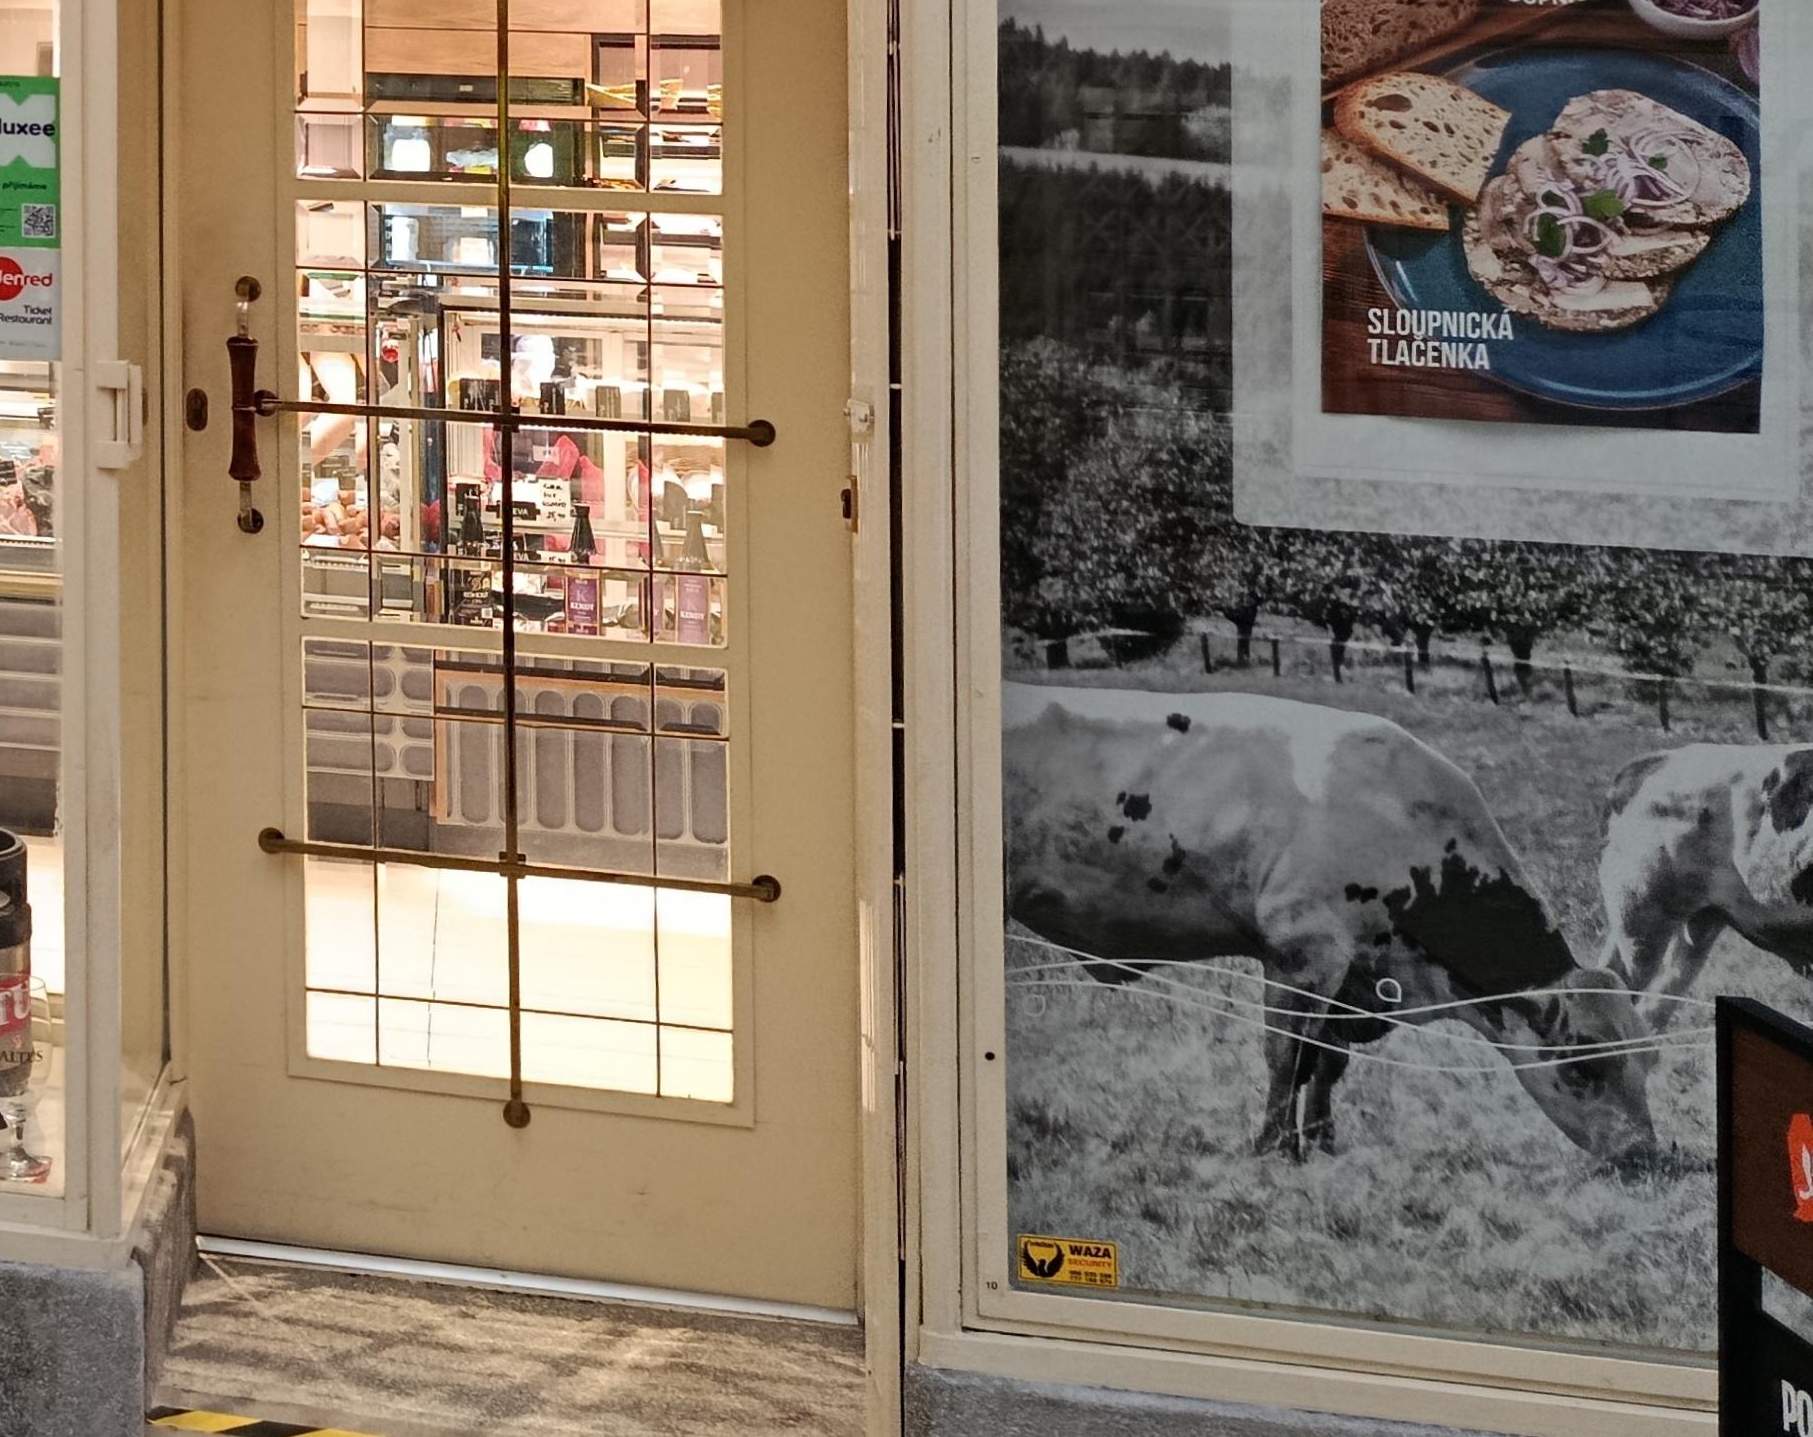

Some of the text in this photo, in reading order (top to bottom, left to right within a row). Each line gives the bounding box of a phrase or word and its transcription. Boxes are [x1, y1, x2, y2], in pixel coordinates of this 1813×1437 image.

[24, 305, 53, 316] Ticket
[1367, 307, 1515, 341] SLOUPNICKÁ
[1367, 334, 1491, 370] TLAČENKA
[1068, 1244, 1112, 1260] WAZA
